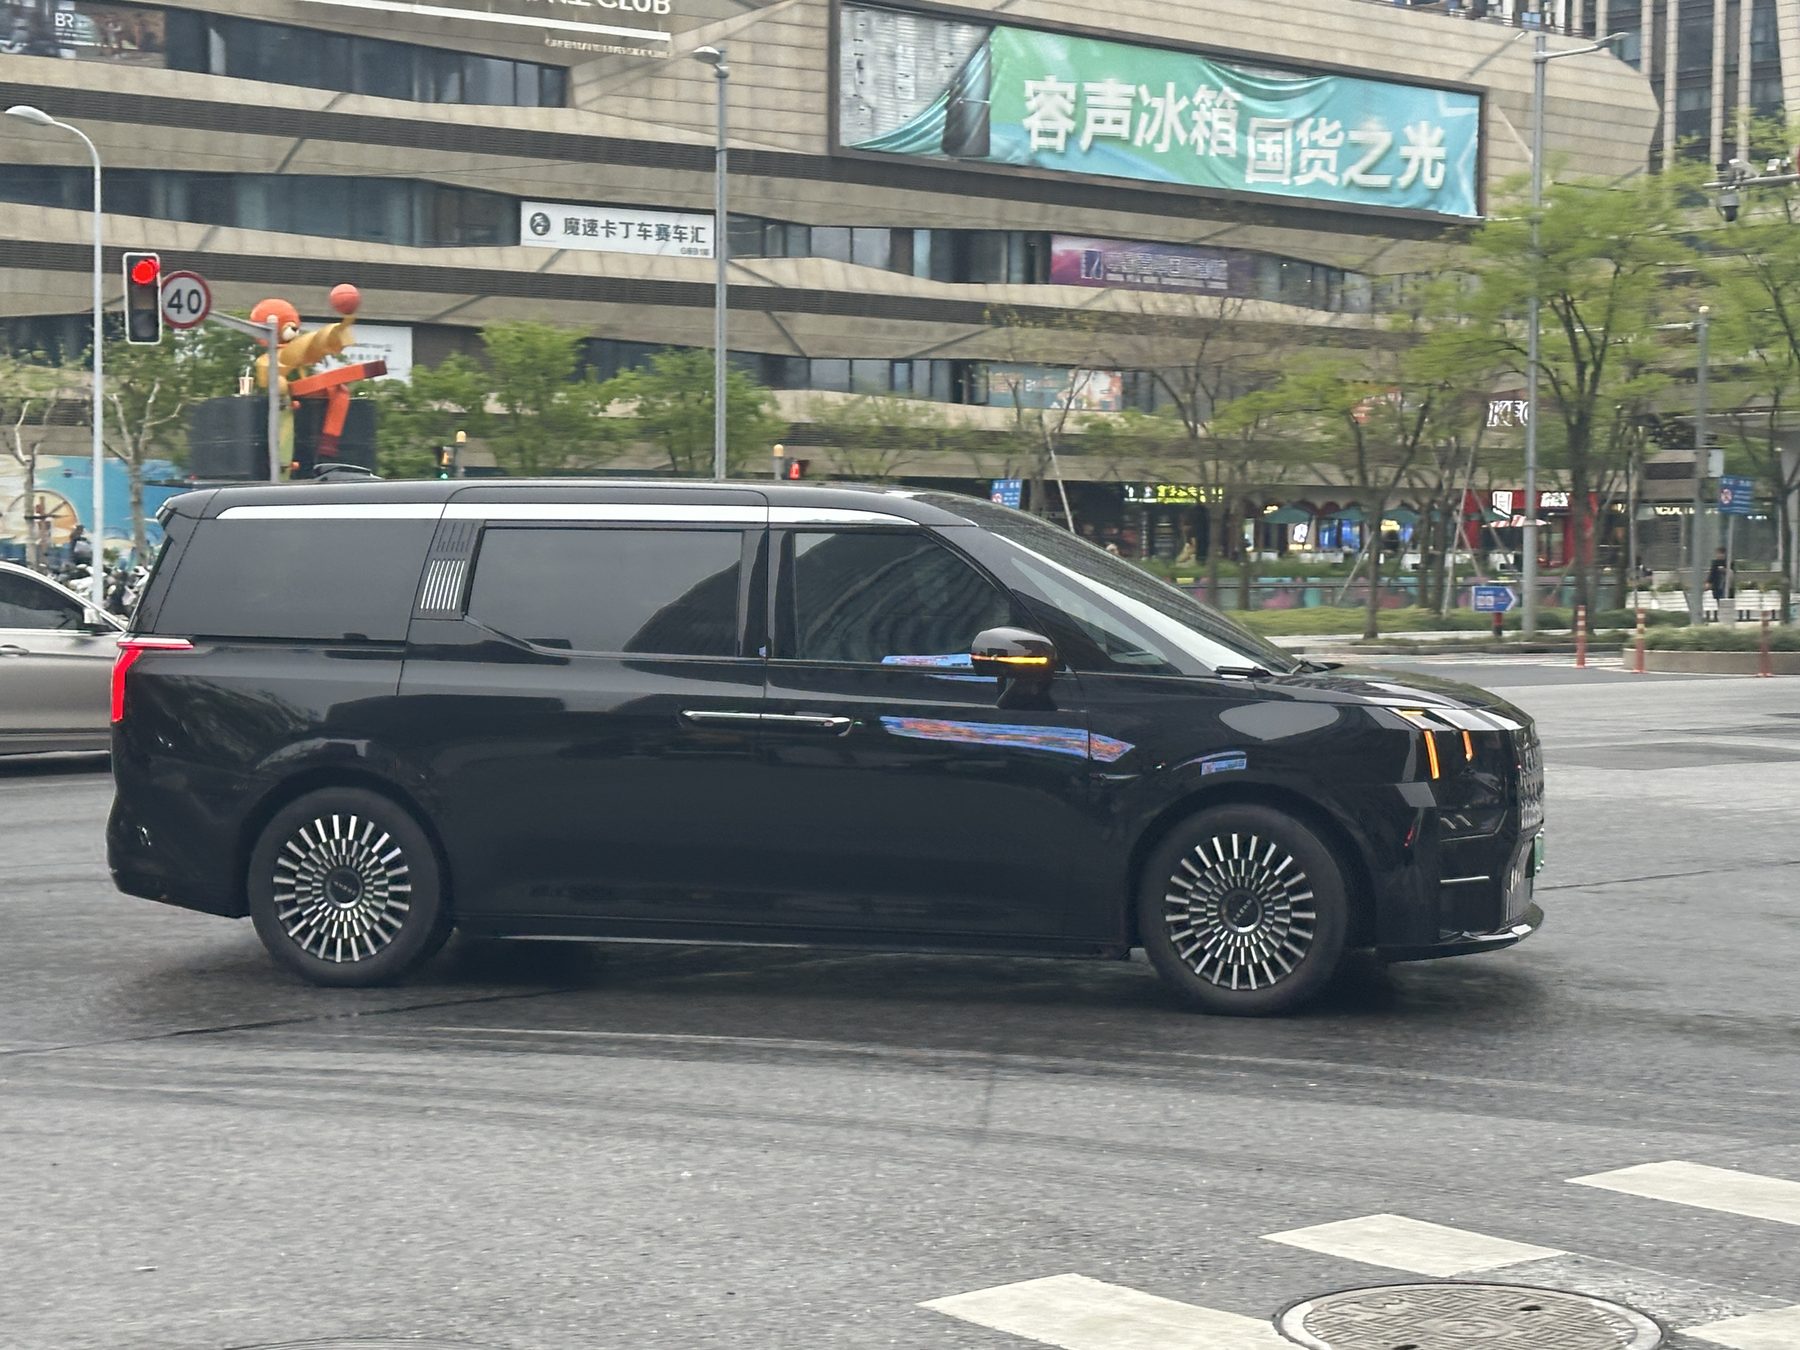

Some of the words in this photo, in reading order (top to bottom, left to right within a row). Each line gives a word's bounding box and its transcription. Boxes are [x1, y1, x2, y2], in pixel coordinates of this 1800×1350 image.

[1022, 75, 1239, 157] 容声冰箱
[1245, 115, 1446, 189] 国货之光
[563, 216, 707, 244] 魔速卡丁车赛车汇
[166, 288, 202, 315] 40
